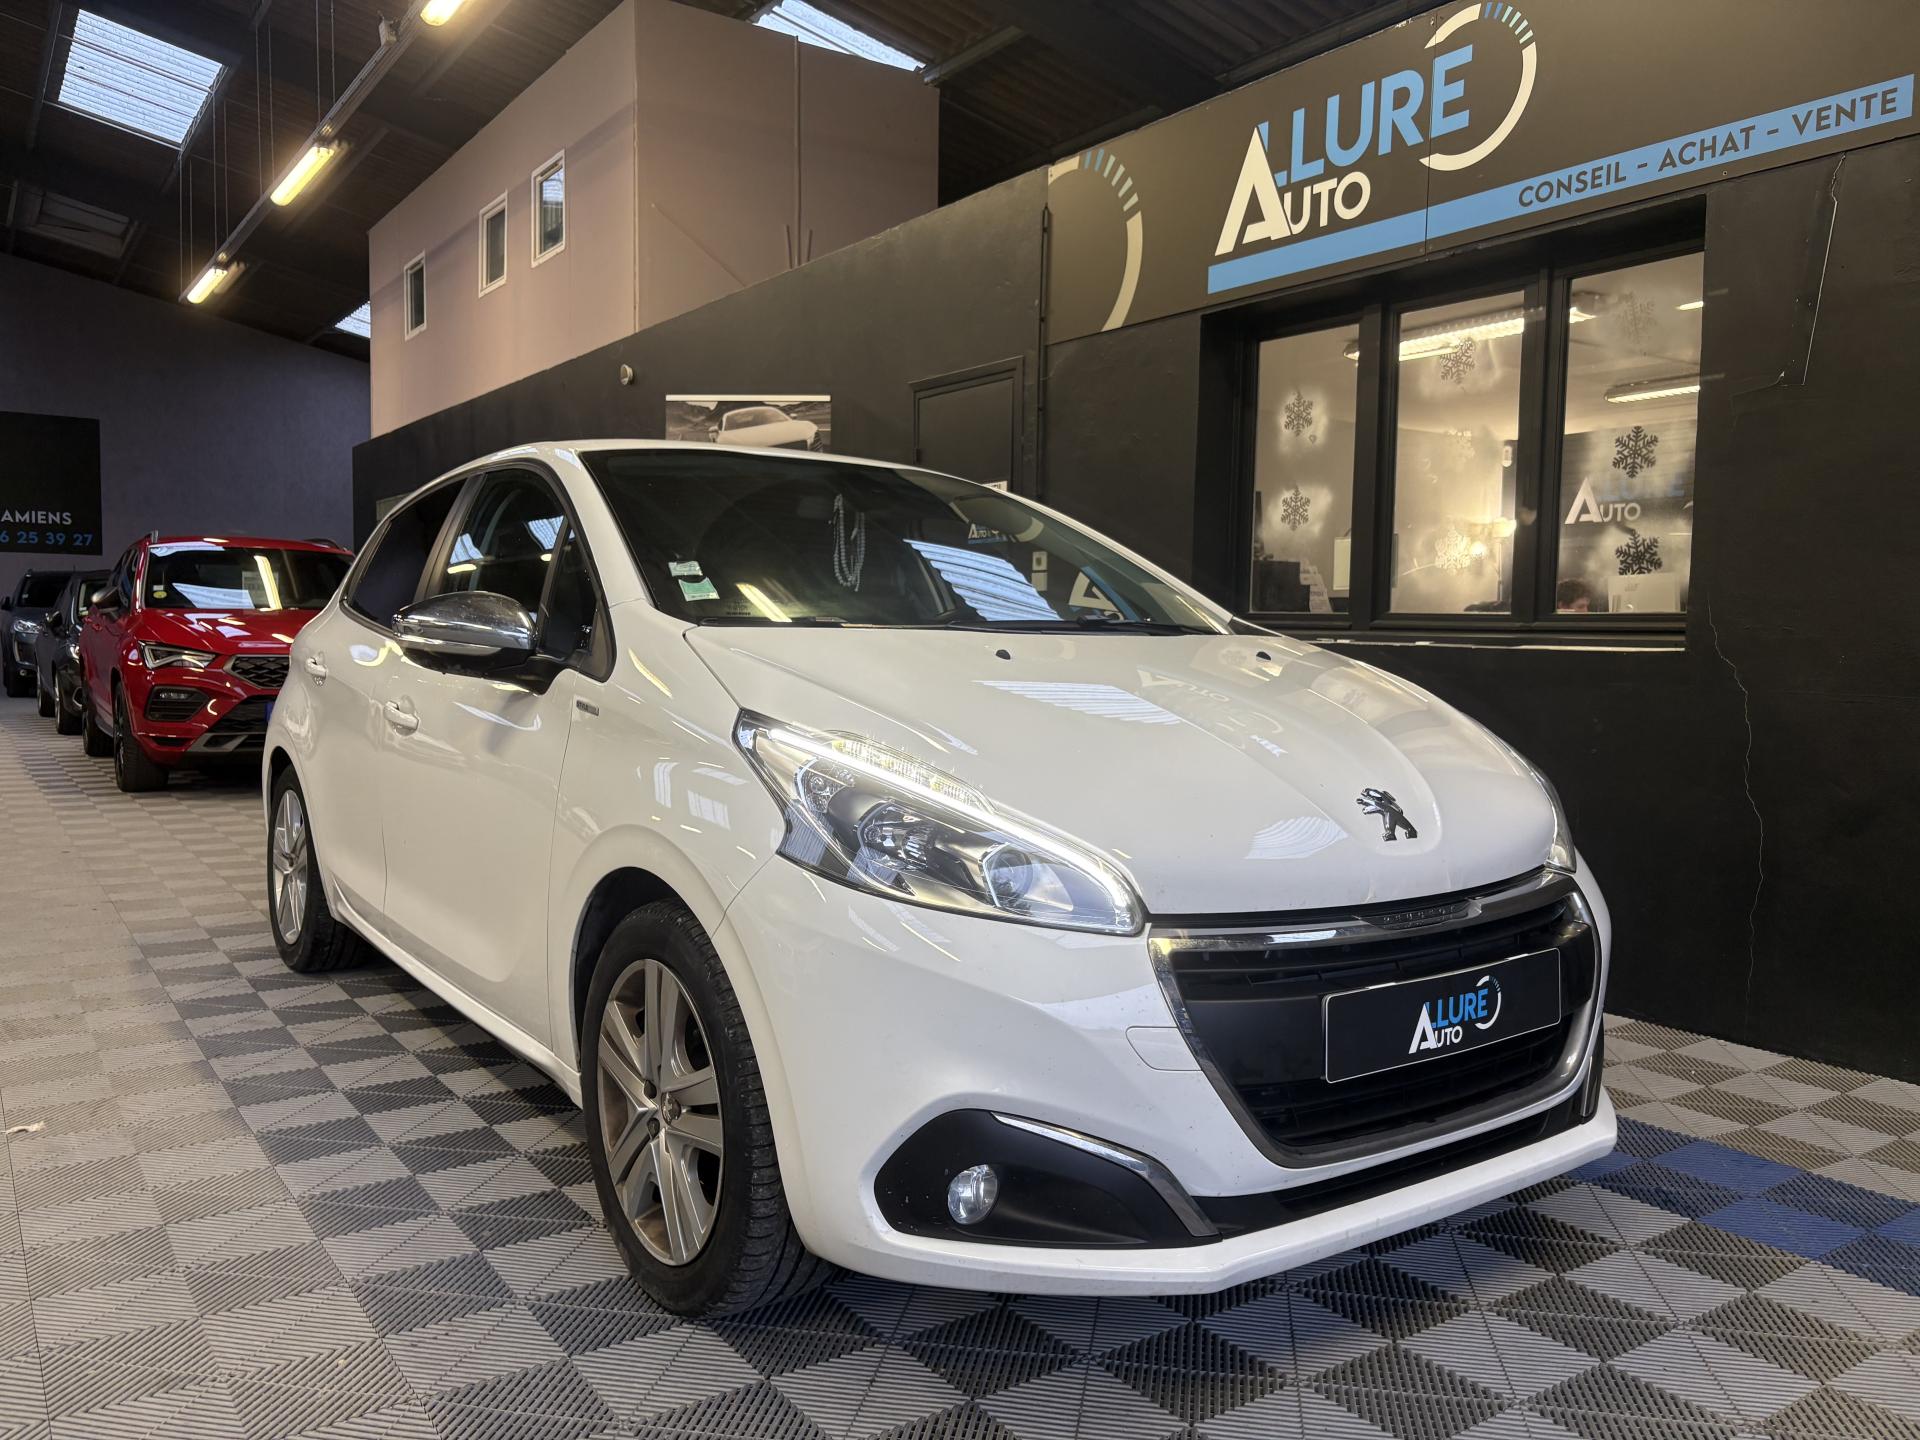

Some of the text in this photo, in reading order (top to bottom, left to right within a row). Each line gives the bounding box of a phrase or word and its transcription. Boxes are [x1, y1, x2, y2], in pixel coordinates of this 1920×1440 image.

[1518, 162, 1626, 207] CONSEIL
[1658, 125, 1756, 173] ACHAT
[1792, 87, 1899, 136] VENTE
[1214, 126, 1371, 256] AUTO
[1, 509, 73, 525] AMIENS
[1565, 477, 1641, 525] AUTO
[17, 531, 39, 544] 25
[46, 532, 66, 545] 39
[72, 533, 93, 546] 27
[1408, 1003, 1463, 1054] AUTO
